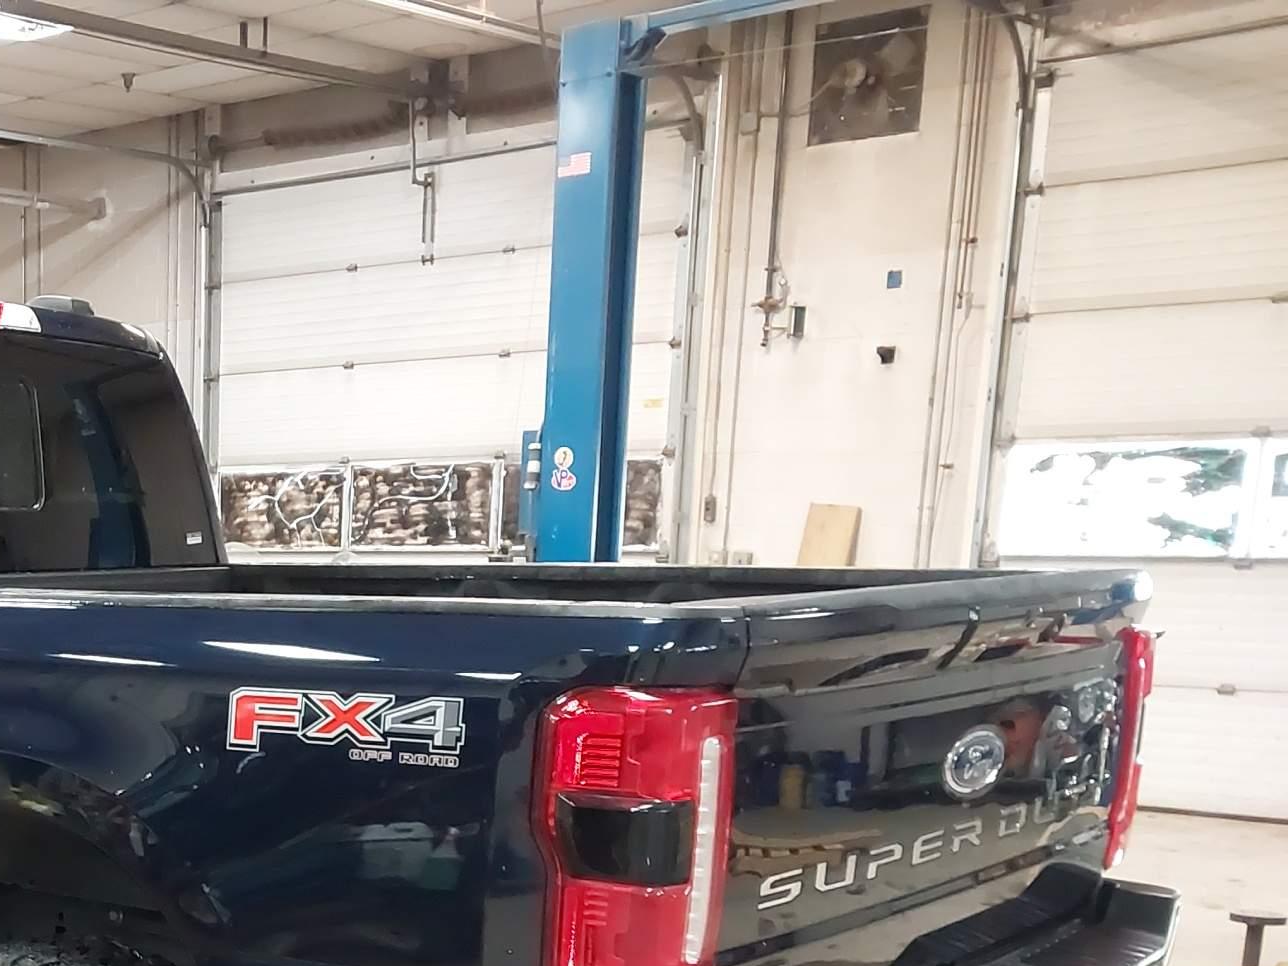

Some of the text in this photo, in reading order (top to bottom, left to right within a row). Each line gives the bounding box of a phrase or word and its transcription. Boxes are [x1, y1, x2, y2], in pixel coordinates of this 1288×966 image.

[226, 687, 465, 754] FX4
[348, 748, 459, 768] OFF ROAD
[757, 816, 983, 910] SUPER
